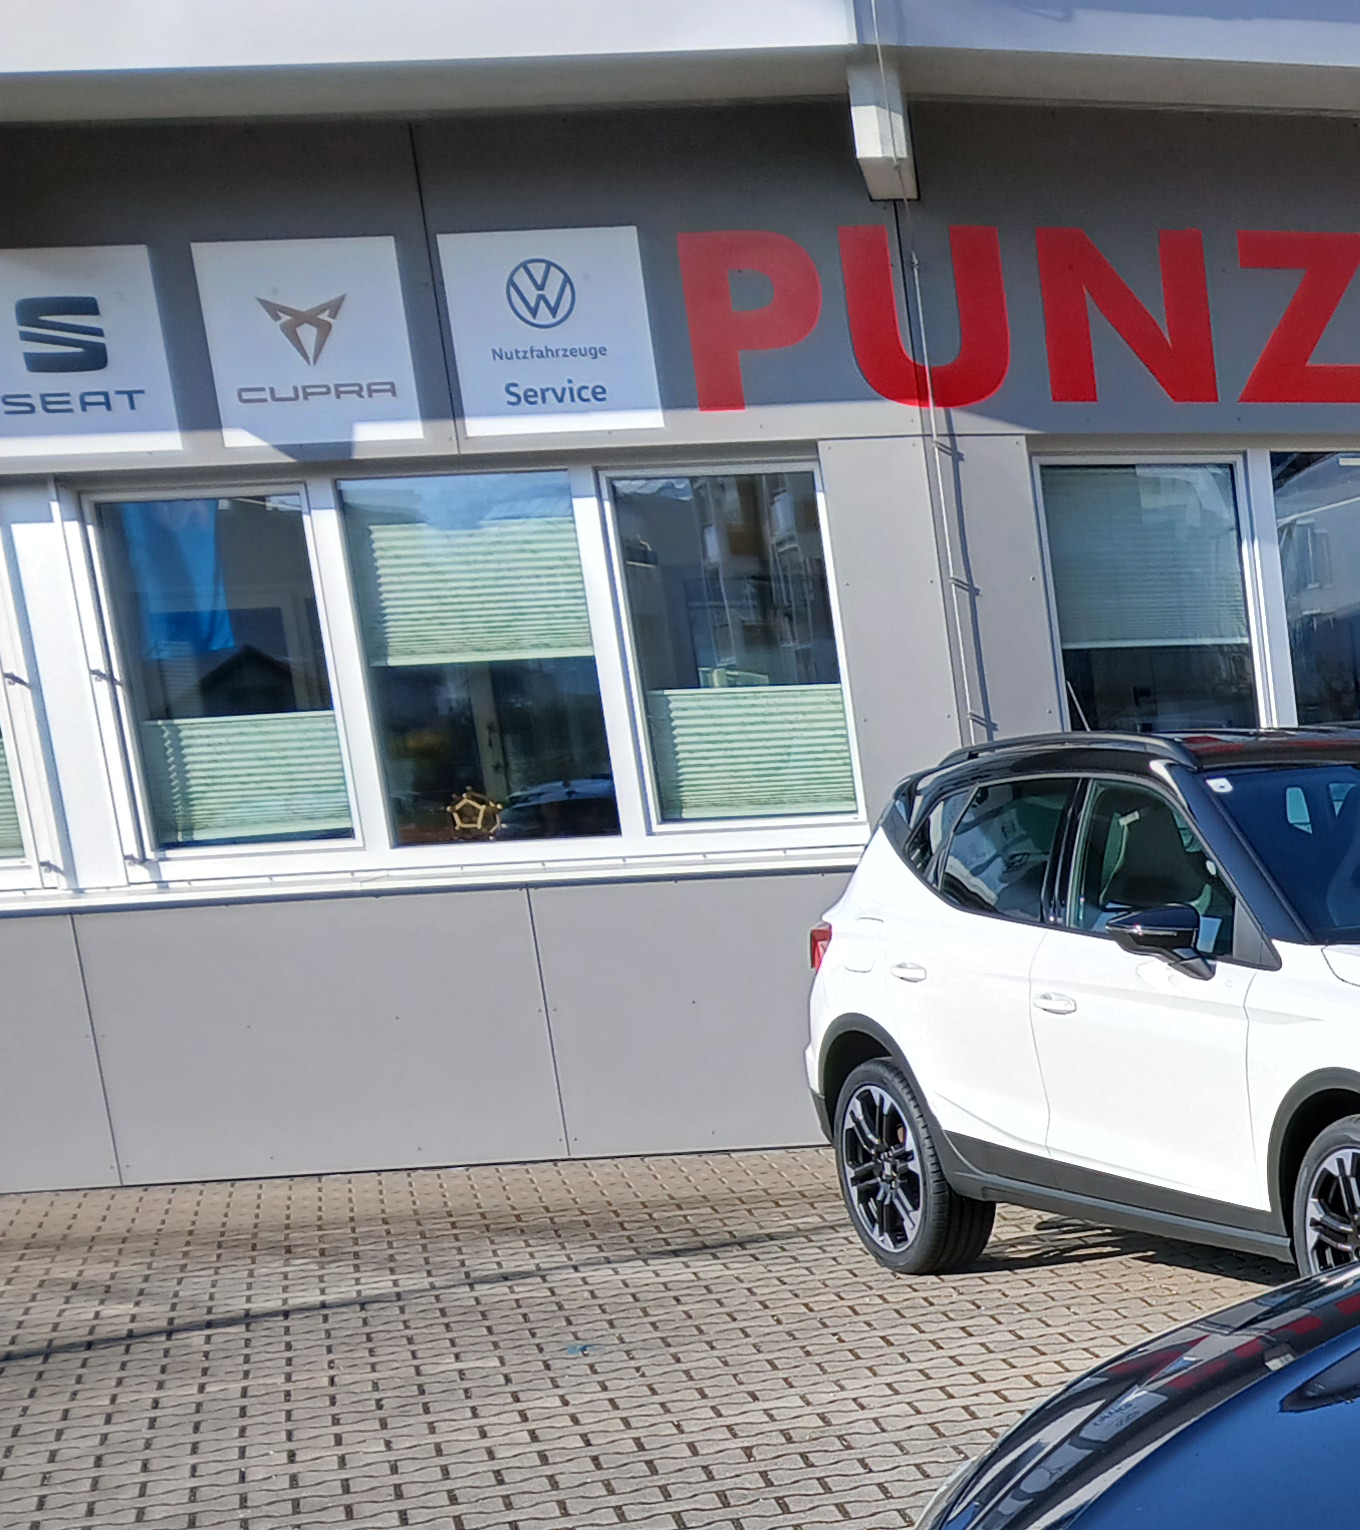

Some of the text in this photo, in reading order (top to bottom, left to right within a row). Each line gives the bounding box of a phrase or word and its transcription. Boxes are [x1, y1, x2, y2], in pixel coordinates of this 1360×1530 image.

[491, 345, 607, 361] Nutzfahrzeuge
[2, 388, 146, 416] SEAT
[236, 380, 397, 405] CUPRA
[504, 378, 607, 406] Service
